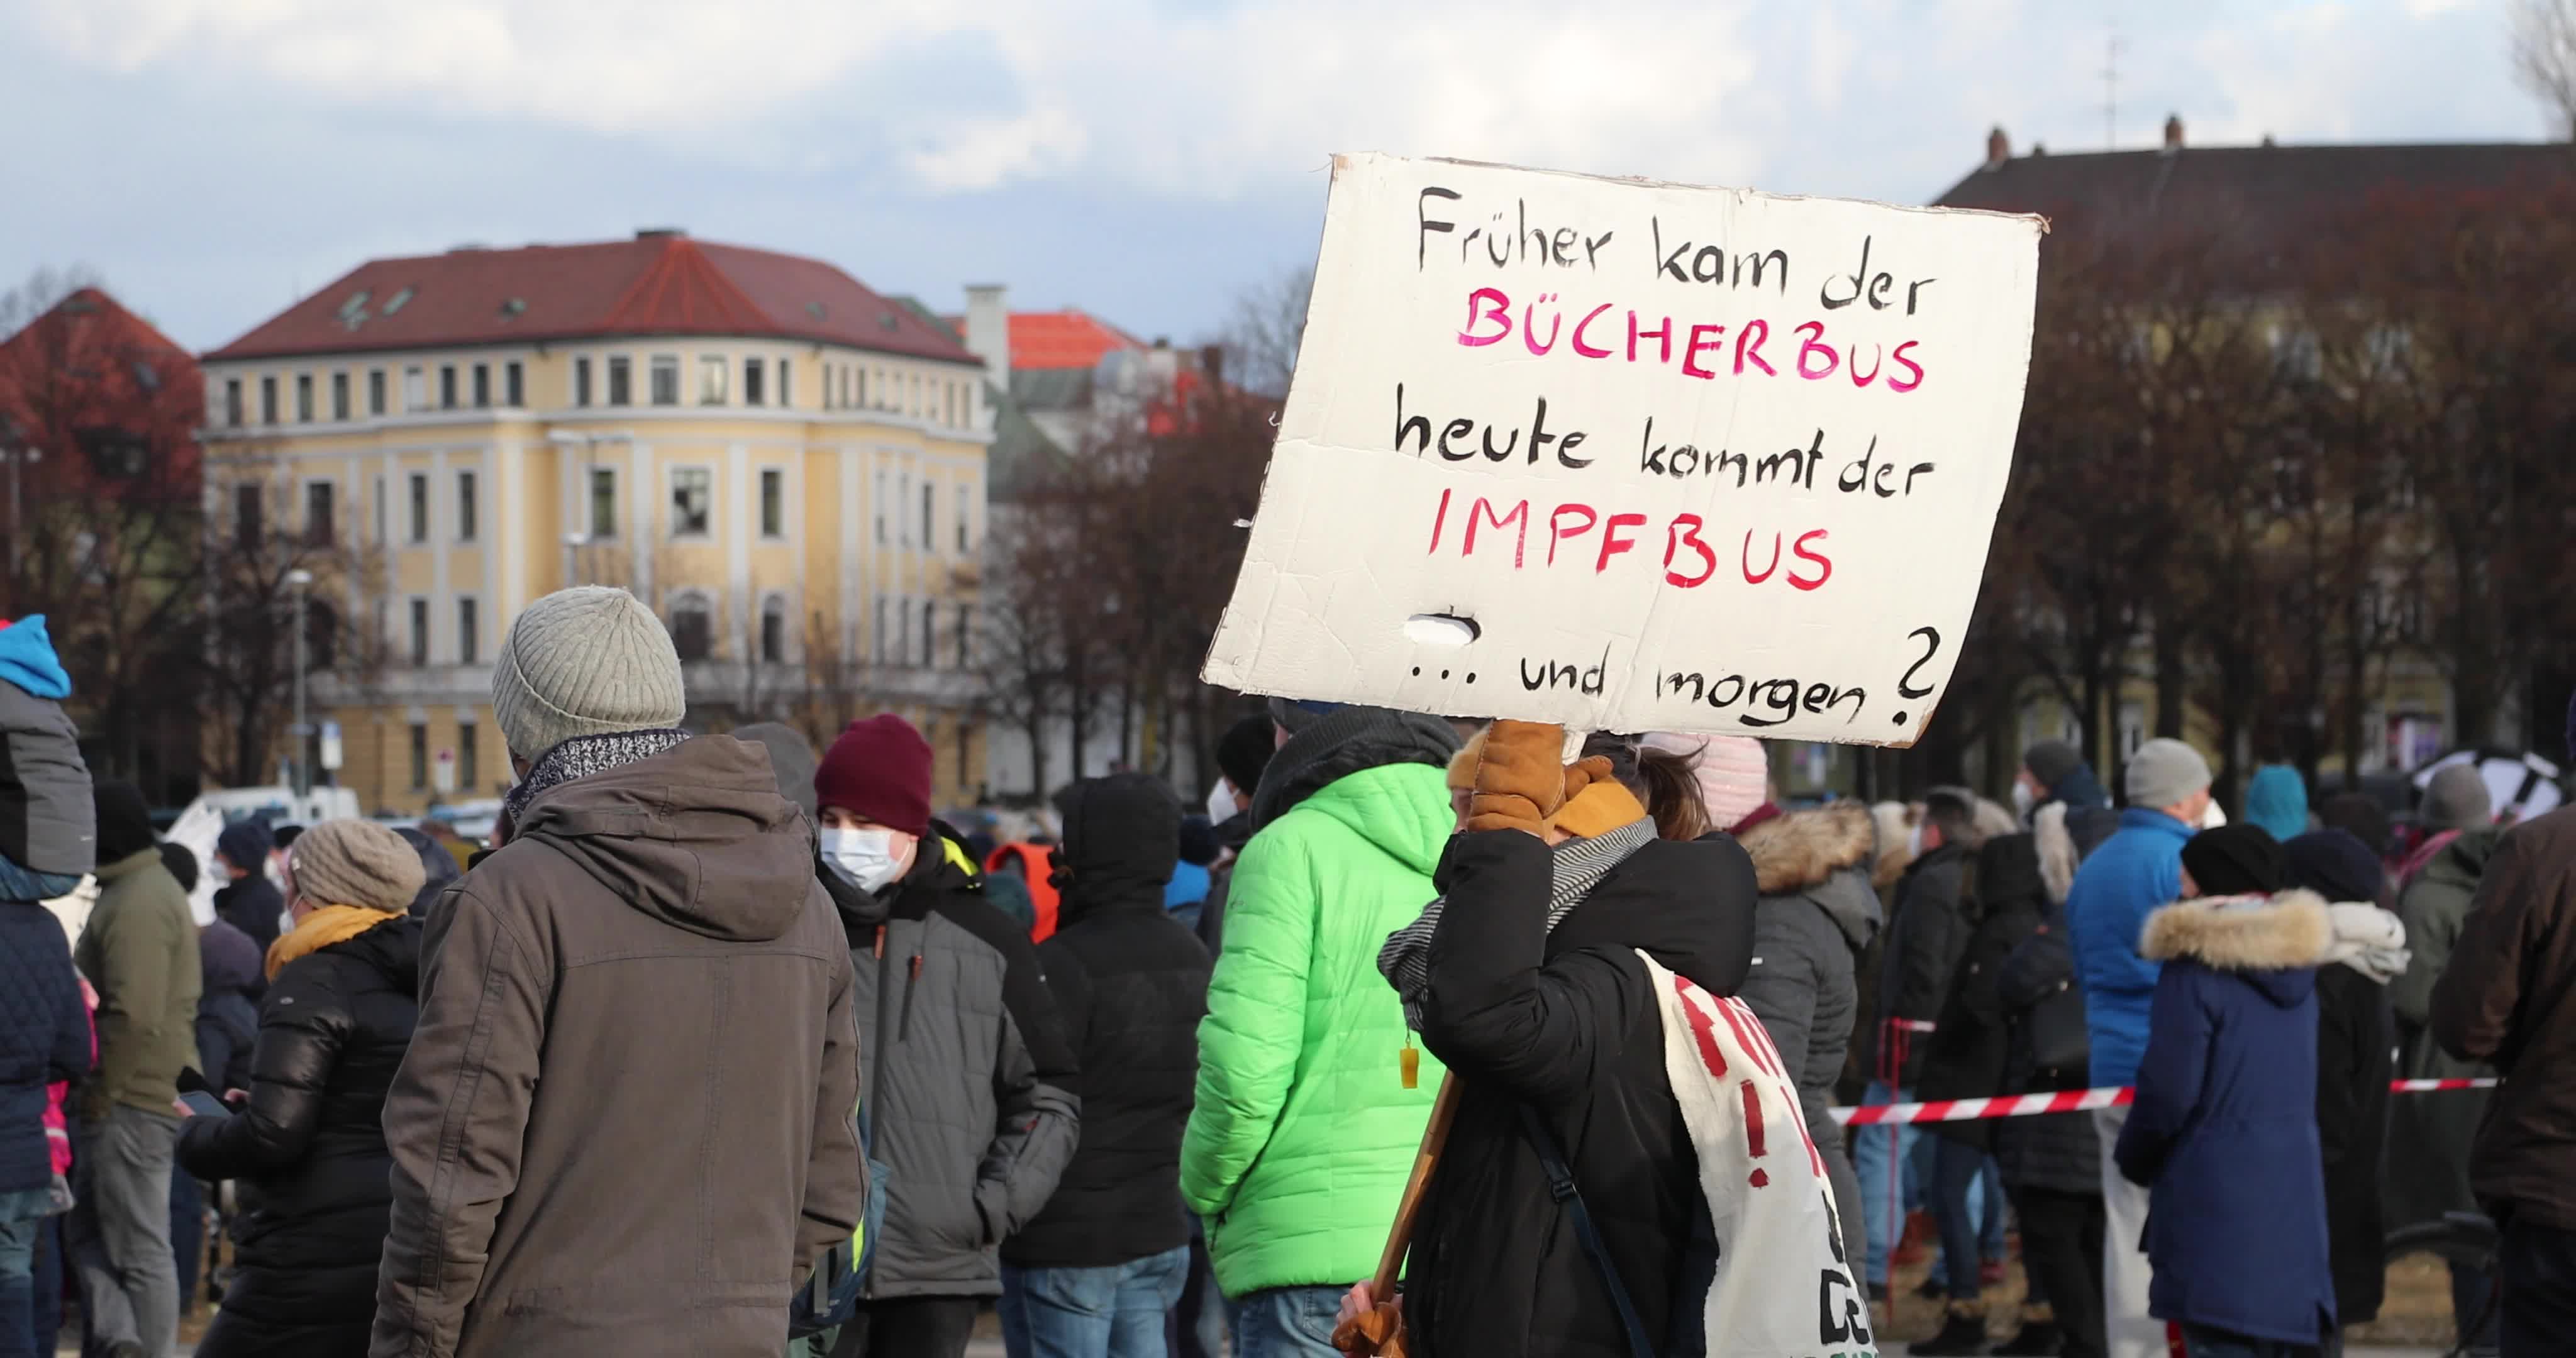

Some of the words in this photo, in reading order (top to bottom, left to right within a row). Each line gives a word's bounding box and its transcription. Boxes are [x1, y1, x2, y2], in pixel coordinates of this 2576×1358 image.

[1419, 187, 1613, 270] Früher
[1653, 216, 1788, 294] kam
[1820, 235, 1938, 316] der
[1458, 287, 1925, 393] BÜCHERBUS
[1395, 382, 1596, 470] heute
[1641, 416, 1824, 490] kommt
[1838, 435, 1937, 498] der
[1521, 642, 1610, 697] und
